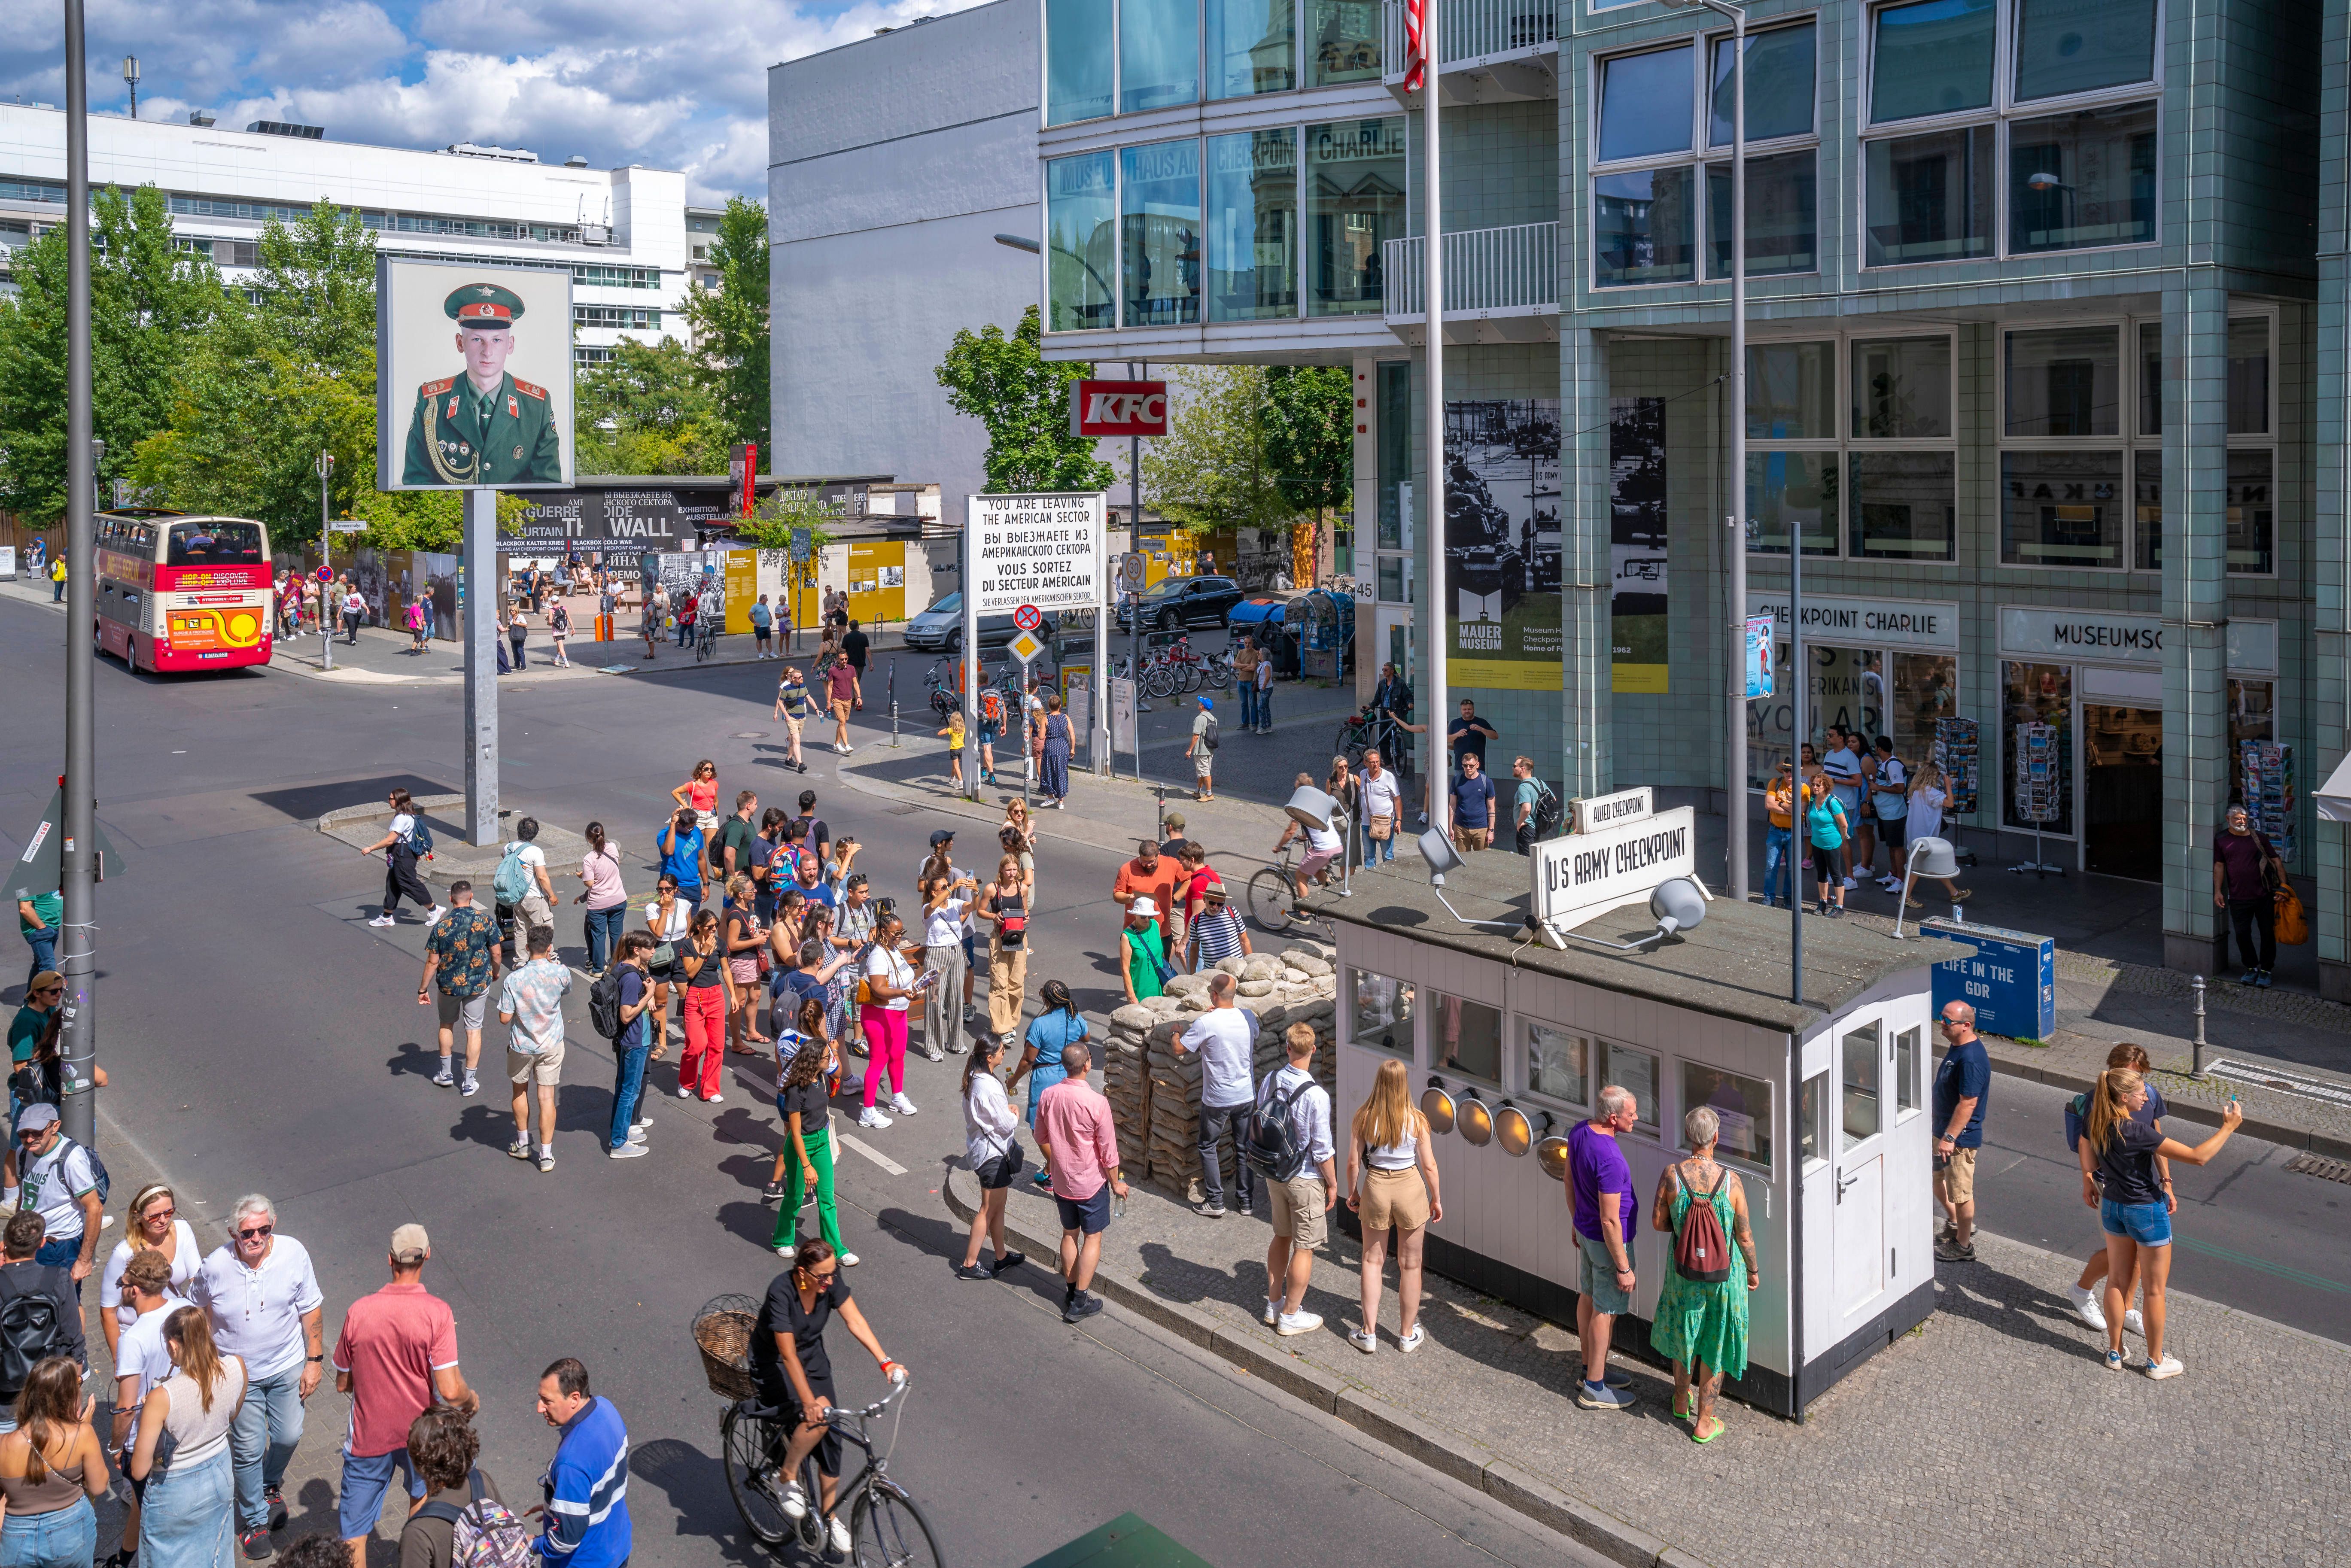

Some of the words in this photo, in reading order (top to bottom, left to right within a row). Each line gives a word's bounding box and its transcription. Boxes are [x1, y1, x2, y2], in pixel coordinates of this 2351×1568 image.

[1062, 158, 1114, 191] MUSEU
[1133, 152, 1174, 181] HAUS
[1178, 148, 1198, 175] AM
[1319, 127, 1404, 161] CHARLIE
[1085, 393, 1165, 423] KFC
[526, 506, 579, 517] GUERRE
[604, 506, 633, 517] OIDE
[988, 499, 1010, 510] YOU
[1016, 498, 1036, 509] ARE
[1043, 497, 1084, 509] LEAVING
[983, 514, 999, 525] THE
[1004, 512, 1052, 524] AMERICAN
[1057, 511, 1089, 523] SECTOR
[610, 518, 673, 537] WALL
[985, 533, 1001, 544] ВЫ
[1007, 530, 1069, 543] ВЫЕЗЖАЕТЕ
[1075, 529, 1088, 541] ИЗ
[982, 545, 1052, 559] АМЕРИКАНСКОГО
[1056, 544, 1091, 556] СЕКТОРА
[122, 559, 139, 581] BERLIN
[611, 570, 642, 579] DEMO
[998, 563, 1027, 575] VOUS
[1033, 561, 1071, 574] SORTEZ
[1129, 562, 1139, 574] 30
[983, 580, 995, 592] DU
[998, 577, 1039, 591] SECTEUR
[1042, 574, 1091, 588] AMÉRICAIN
[1357, 583, 1372, 597] 45
[991, 596, 1019, 606] VERLASSEN
[1020, 595, 1030, 604] DEN
[1031, 593, 1072, 604] AMERIKANISCHEN
[1073, 592, 1090, 601] SEKTOR
[1746, 618, 1771, 626] DESTINATION
[1761, 605, 1858, 629] CHEKPOINT
[1865, 612, 1936, 634] CHARLIE
[1459, 625, 1501, 639] MAUER
[1459, 638, 1502, 650] MUSEUM
[1594, 805, 1610, 824] ALLIED
[1612, 795, 1644, 818] CHECKPOINT
[26, 843, 39, 861] Falkensee
[1575, 847, 1610, 885] ARMY
[1616, 827, 1686, 874] CHECKPOINT
[1943, 959, 1967, 974] LIFE
[1973, 961, 1985, 977] IN
[1990, 965, 2014, 983] THE
[1965, 981, 1989, 999] GDR
[24, 1168, 49, 1185] LLINOIS
[21, 1181, 40, 1210] 5
